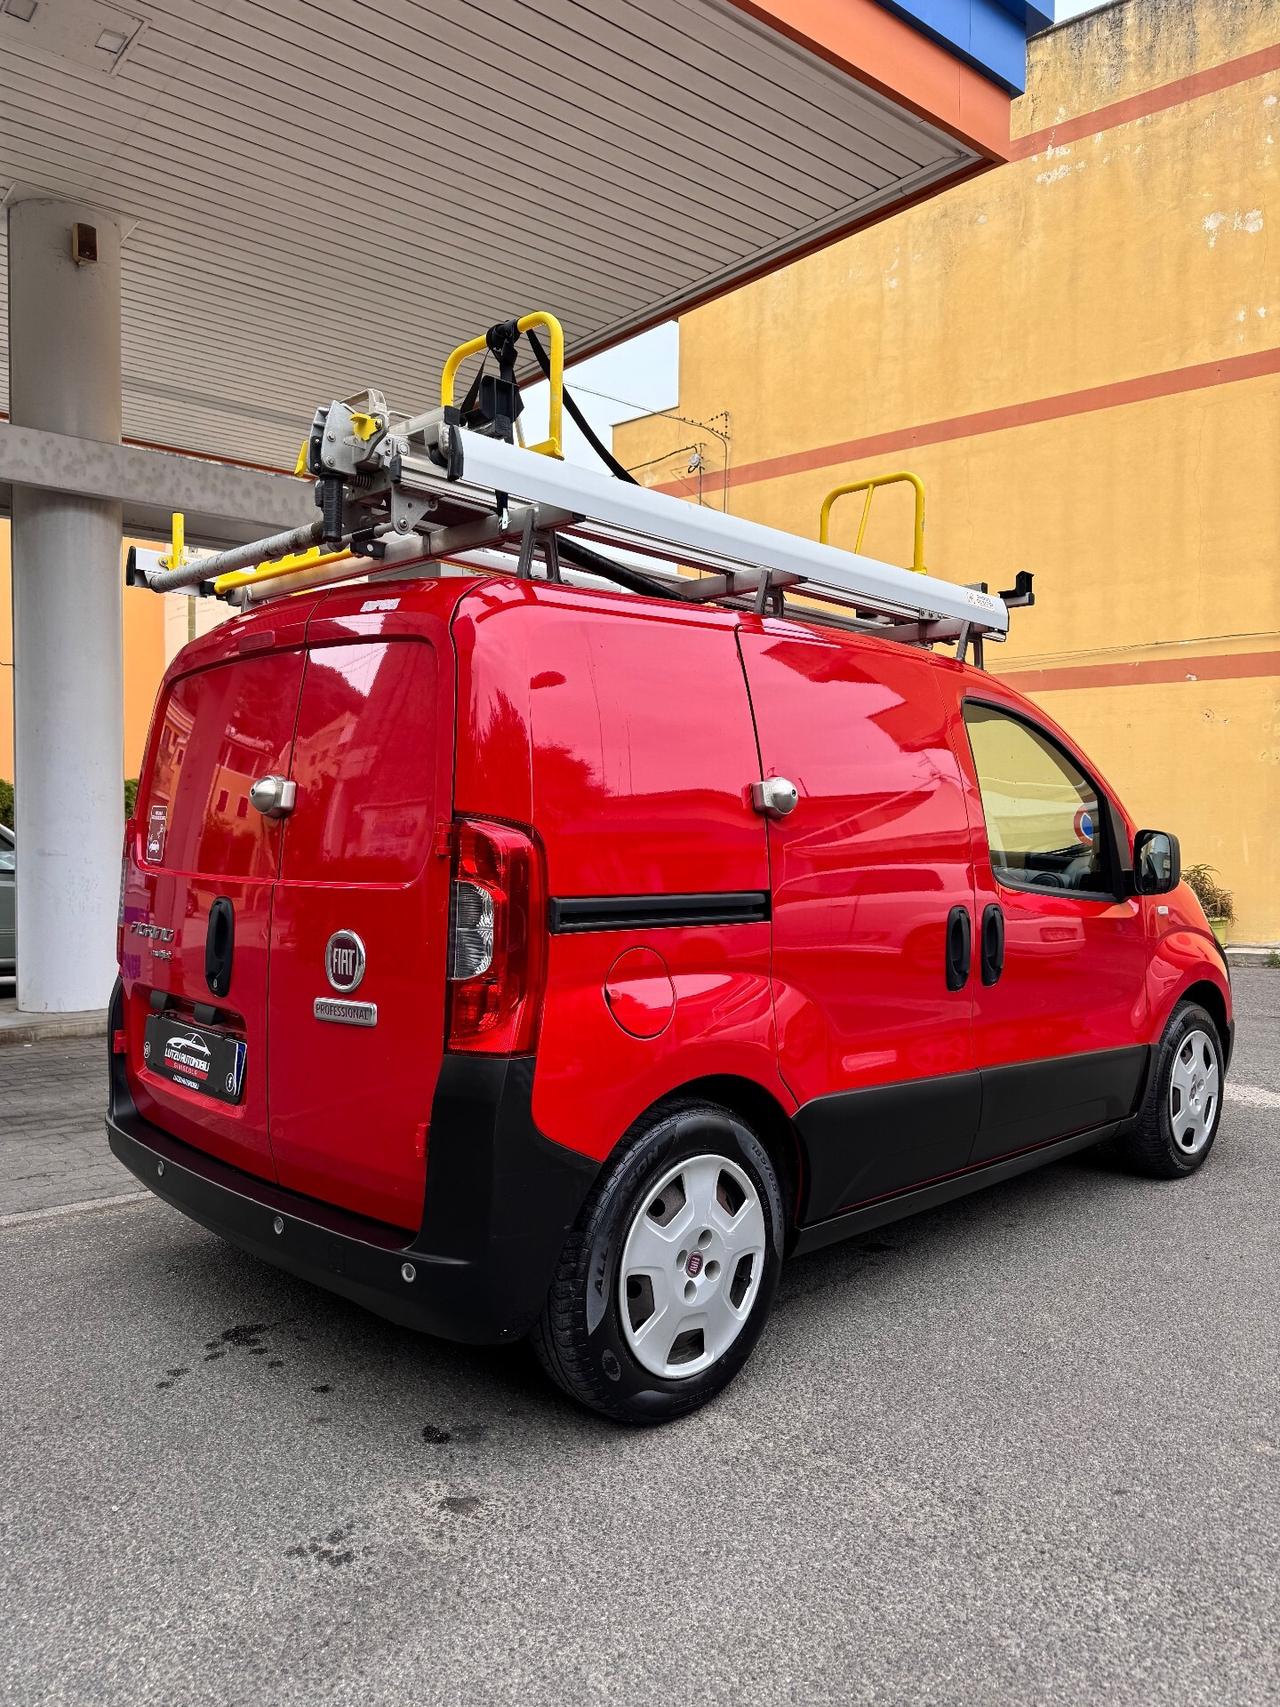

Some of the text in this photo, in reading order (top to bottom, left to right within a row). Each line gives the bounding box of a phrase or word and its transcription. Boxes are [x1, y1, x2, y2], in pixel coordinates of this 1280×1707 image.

[333, 947, 356, 976] FIAT
[315, 1003, 369, 1021] PROFESSIONAL
[594, 1247, 609, 1298] ALL
[689, 1256, 700, 1274] FIAT
